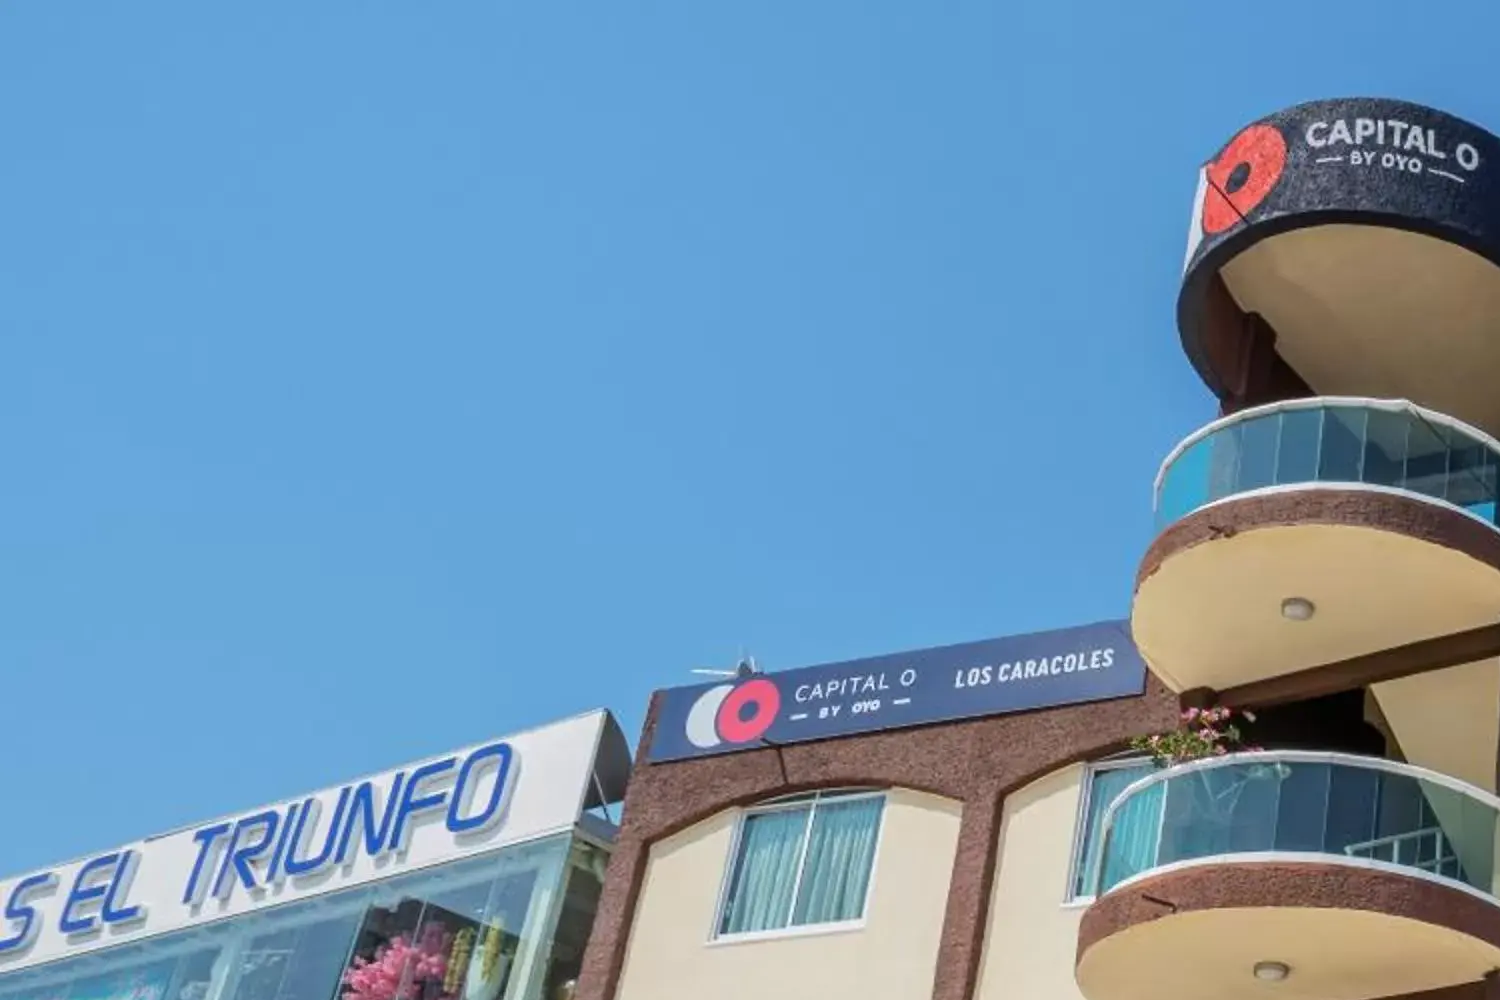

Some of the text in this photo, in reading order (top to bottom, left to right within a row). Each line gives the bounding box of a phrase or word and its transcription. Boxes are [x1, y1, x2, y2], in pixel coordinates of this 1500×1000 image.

[1305, 118, 1479, 170] CAPITAL O
[1350, 151, 1423, 173] BY OYO
[796, 669, 917, 702] CAPITAL O
[955, 648, 1115, 689] LOS CARACOLES
[819, 700, 881, 719] BY OYO
[60, 851, 141, 933] EL
[183, 742, 513, 903] TRIUNFO
